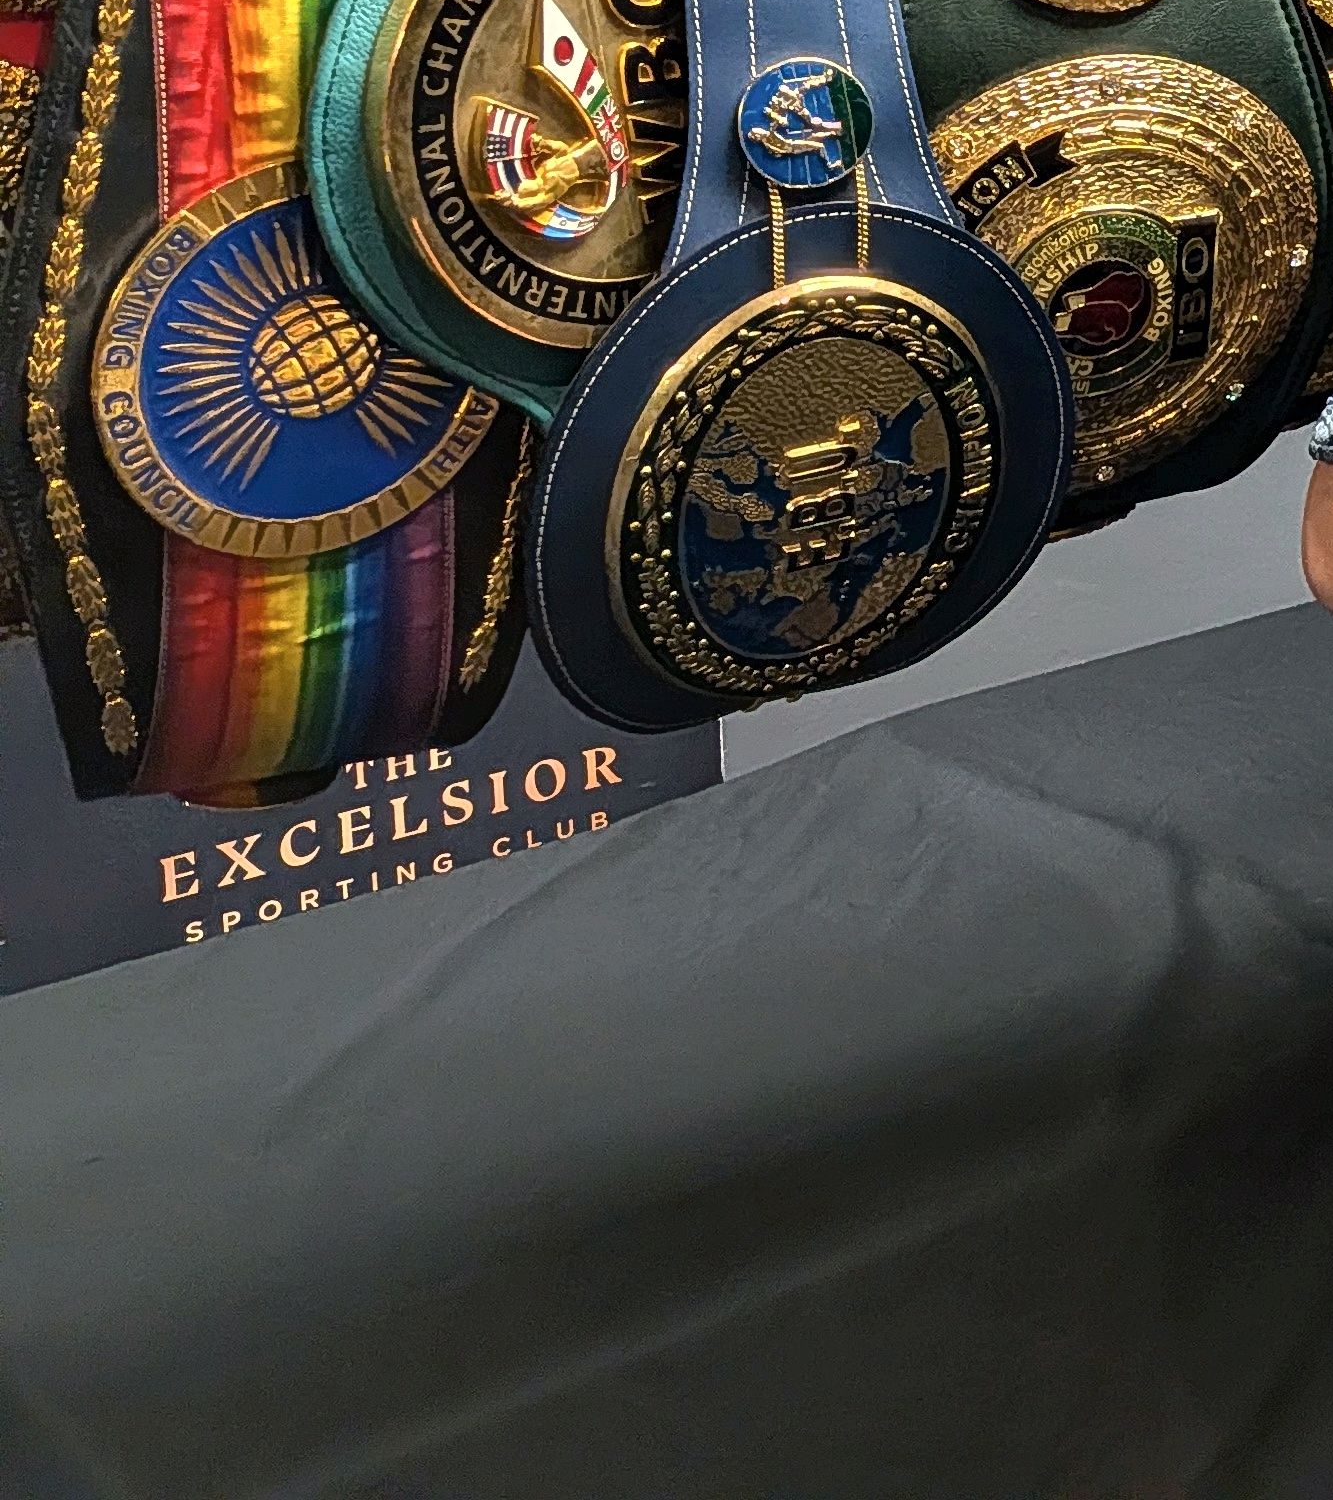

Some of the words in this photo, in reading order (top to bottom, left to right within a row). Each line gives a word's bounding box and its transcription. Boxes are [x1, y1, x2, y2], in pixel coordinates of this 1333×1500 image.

[101, 232, 198, 370] BOXING
[1142, 256, 1176, 342] BOXING
[101, 391, 201, 533] COUNCIL
[158, 746, 623, 903] EXCELSIOR
[344, 747, 454, 790] THE
[184, 852, 455, 943] SPORTING
[491, 811, 610, 858] CLUB
